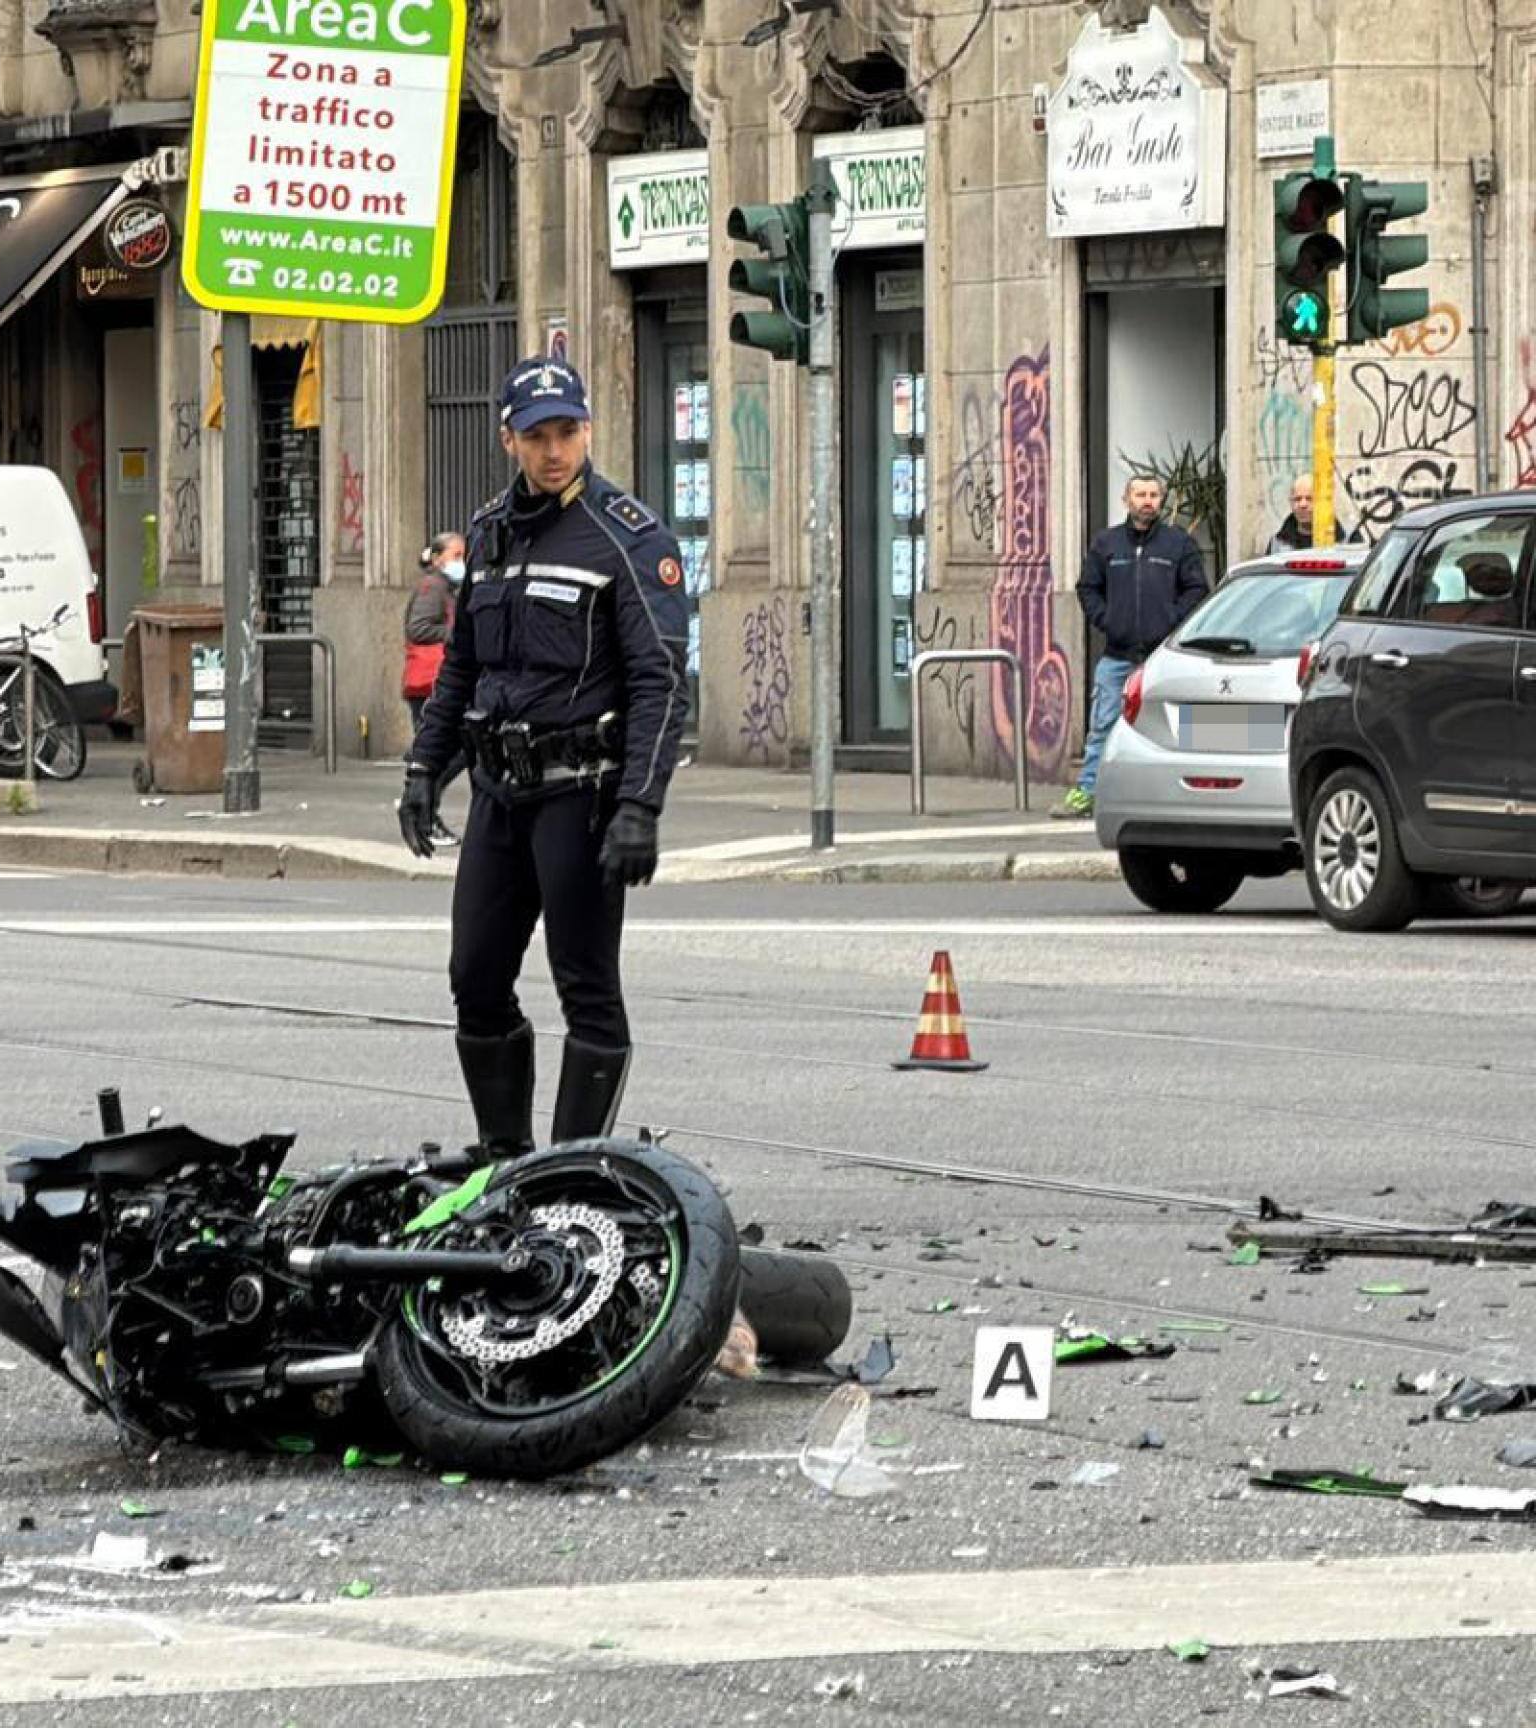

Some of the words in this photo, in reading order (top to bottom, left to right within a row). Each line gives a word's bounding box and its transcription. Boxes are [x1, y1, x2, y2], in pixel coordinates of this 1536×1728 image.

[266, 53, 358, 85] Zona
[374, 67, 393, 88] a
[258, 95, 395, 130] traffico
[248, 135, 397, 173] limitato
[1066, 117, 1113, 170] Bar
[232, 184, 252, 205] a
[264, 179, 352, 211] 1500
[362, 189, 408, 215] mt
[219, 226, 414, 259] www.AreaC.it
[272, 267, 400, 298] 02.02.02
[982, 1341, 1039, 1400] A
